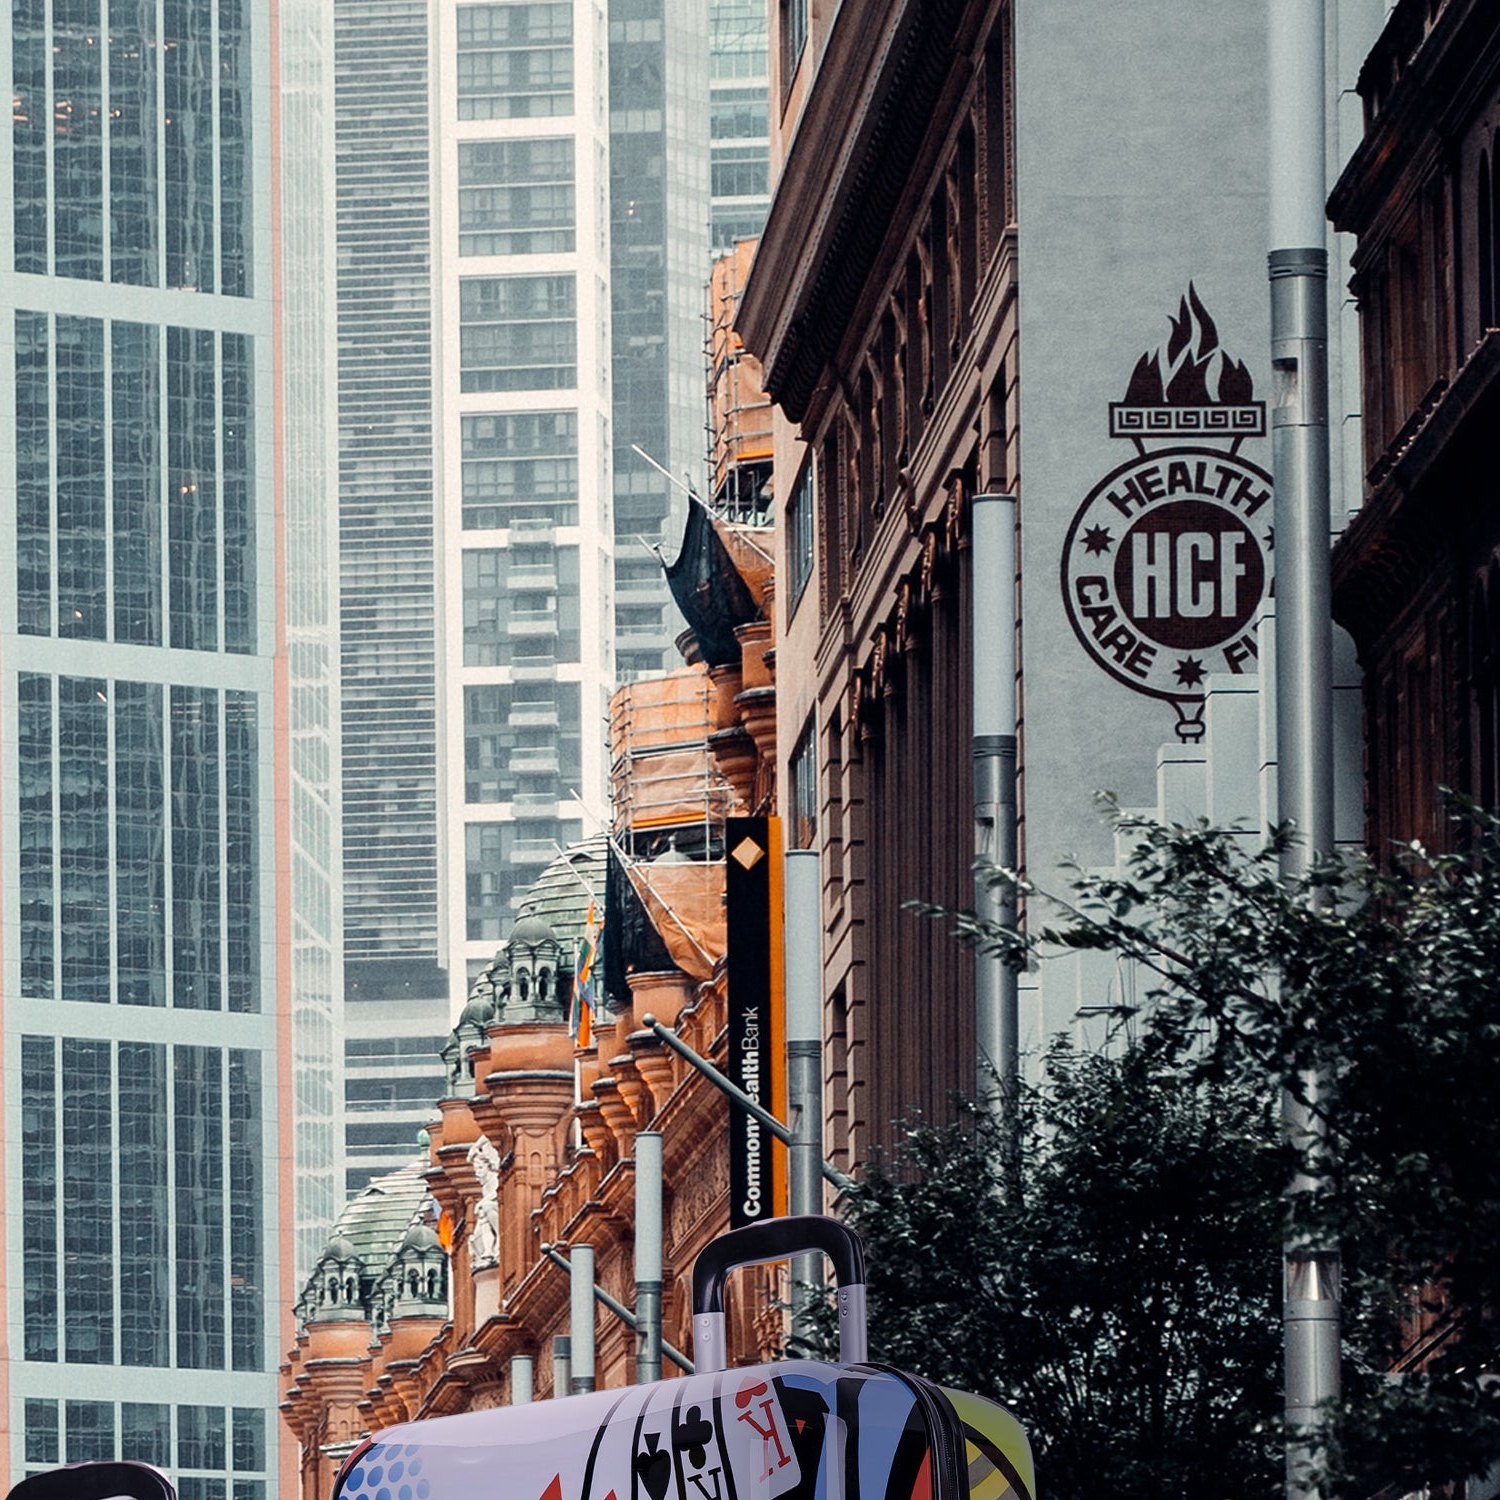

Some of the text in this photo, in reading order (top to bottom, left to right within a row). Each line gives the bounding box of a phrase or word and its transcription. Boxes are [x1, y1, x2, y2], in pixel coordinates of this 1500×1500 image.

[1105, 461, 1271, 518] HEALTH
[1132, 531, 1246, 618] HCF
[1075, 576, 1158, 679] CARE
